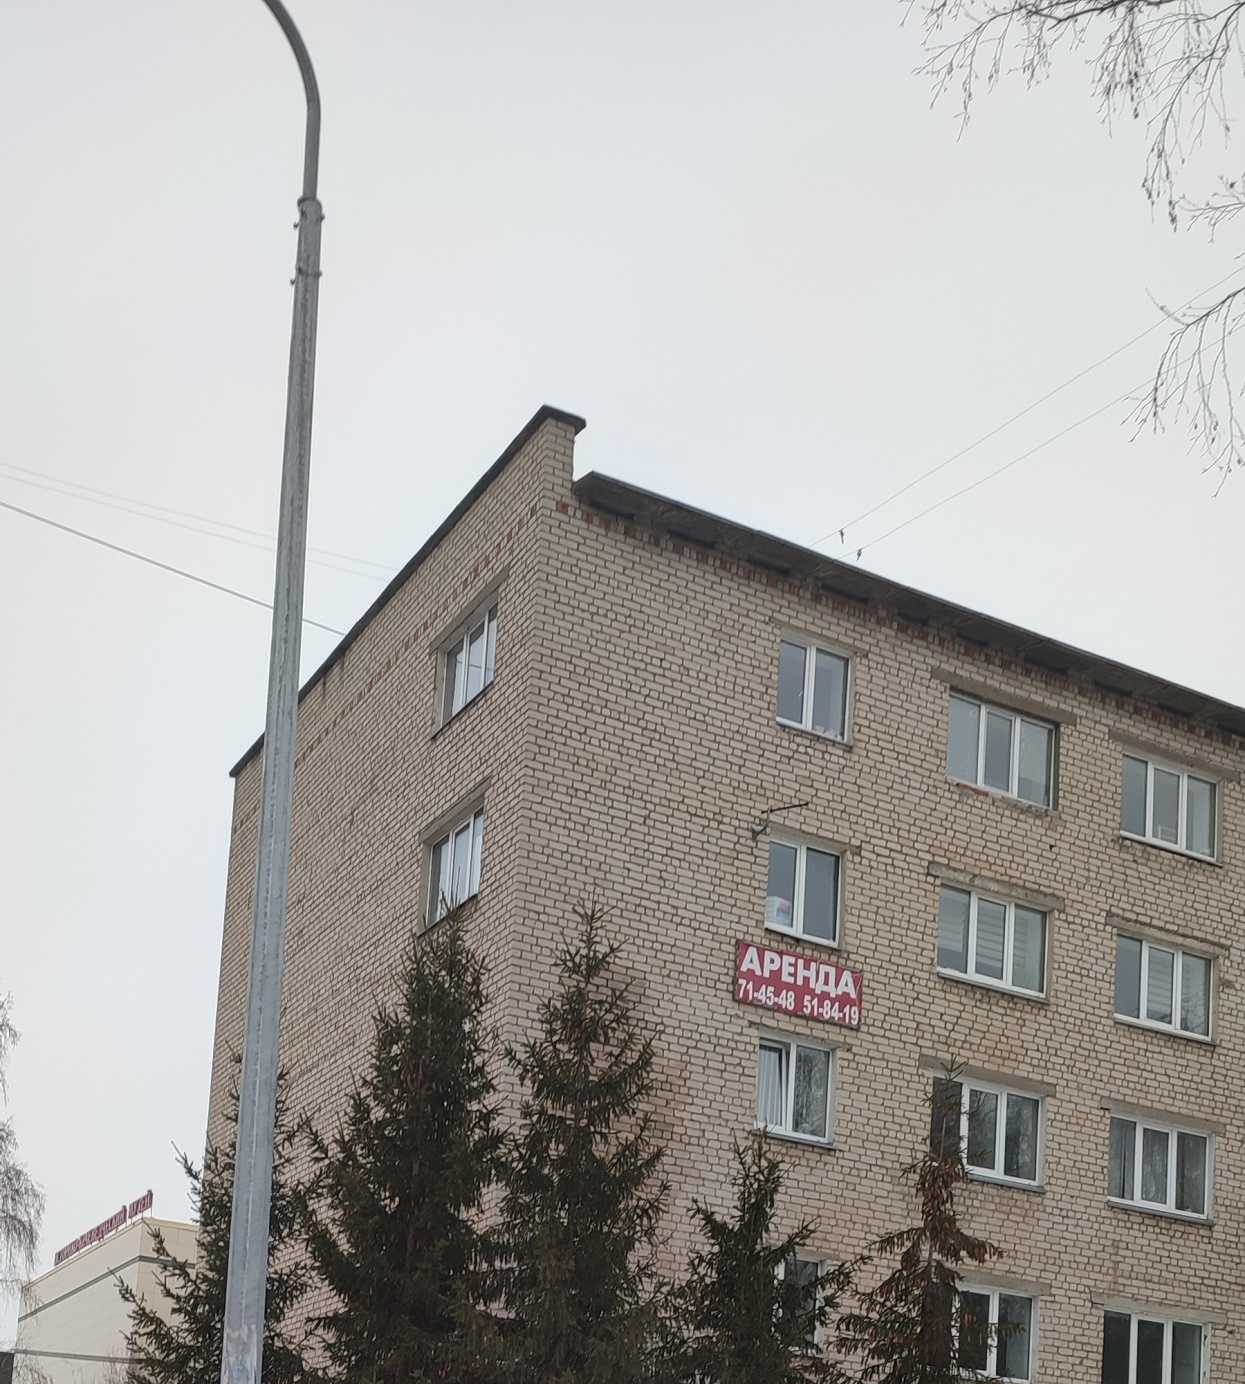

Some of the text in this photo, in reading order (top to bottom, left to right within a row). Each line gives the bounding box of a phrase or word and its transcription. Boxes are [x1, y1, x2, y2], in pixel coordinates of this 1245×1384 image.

[740, 946, 857, 998] АРЕНДА
[738, 978, 859, 1025] 71-45-48 51-84-19
